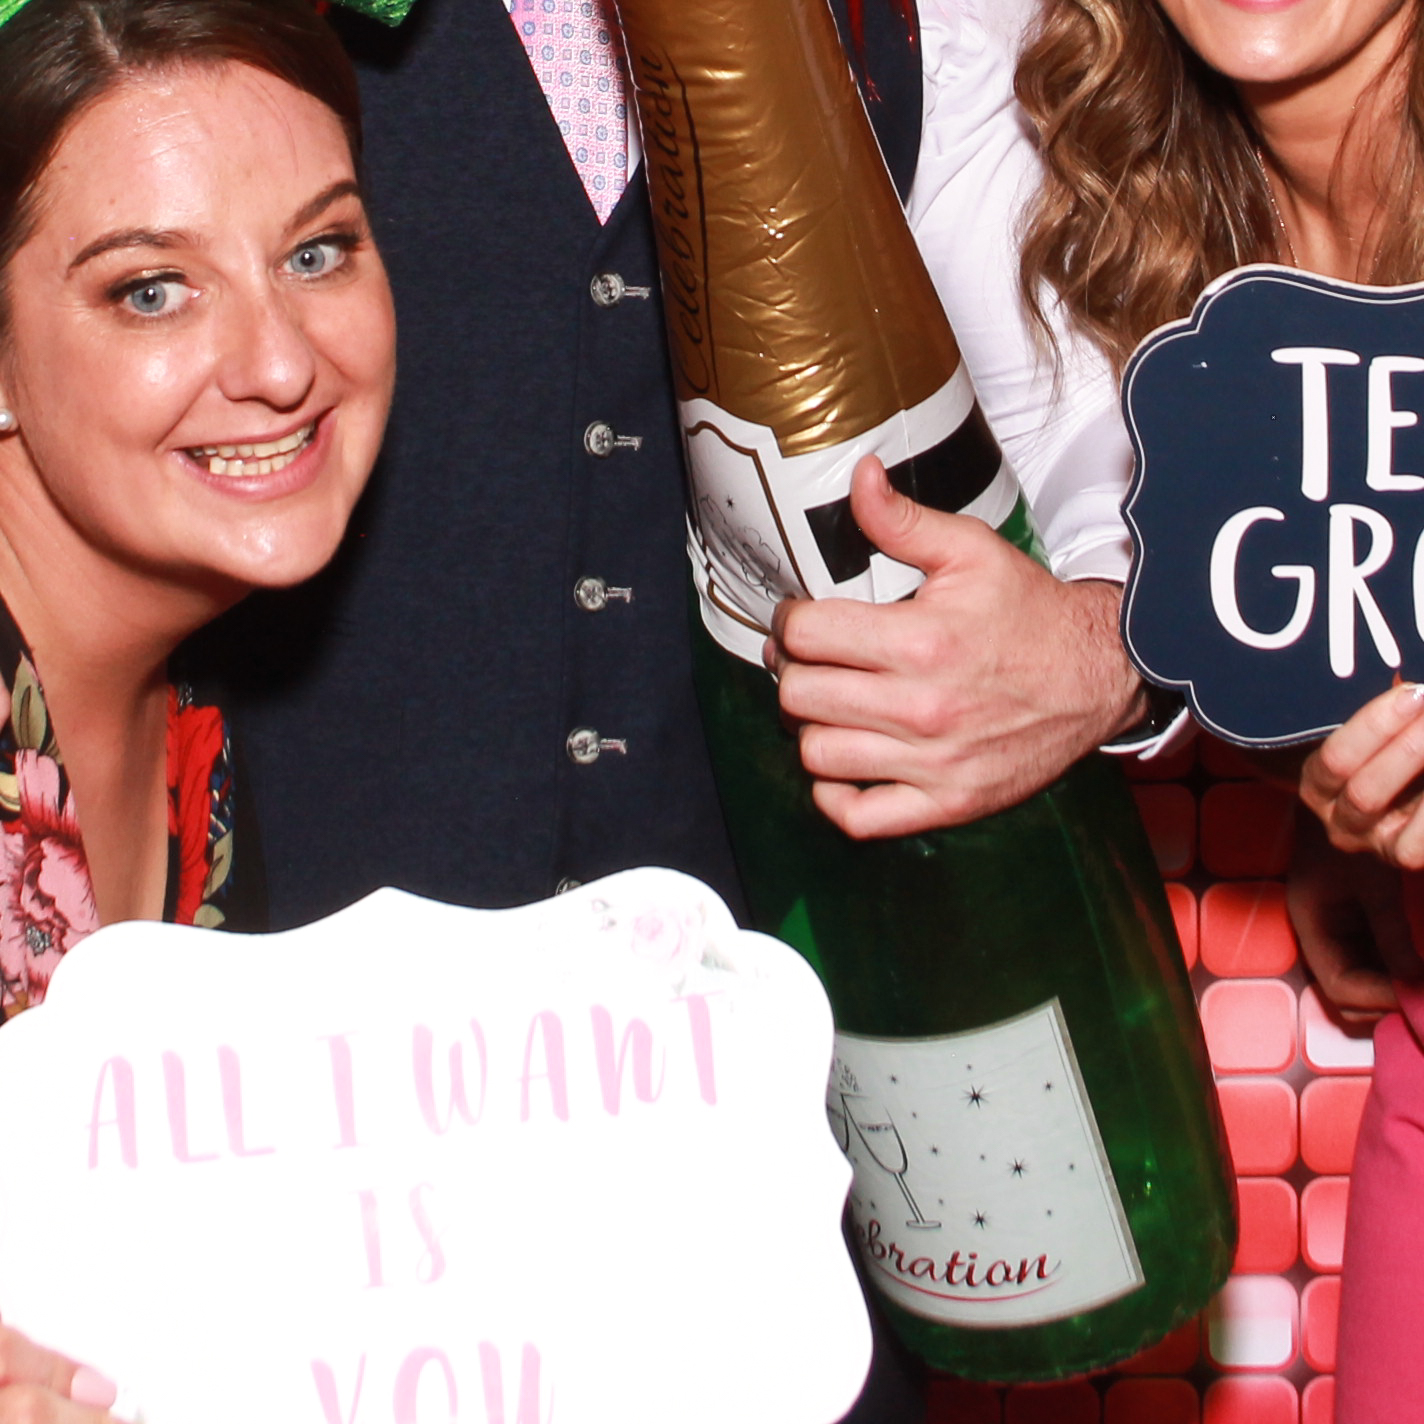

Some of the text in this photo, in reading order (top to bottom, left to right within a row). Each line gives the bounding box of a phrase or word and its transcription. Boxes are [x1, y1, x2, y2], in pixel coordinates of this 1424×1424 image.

[640, 50, 711, 396] Celebration
[85, 989, 725, 1171] ALL I WANT
[348, 1180, 449, 1290] IS
[854, 1218, 1061, 1287] ebration
[309, 1339, 555, 1424] YOU
